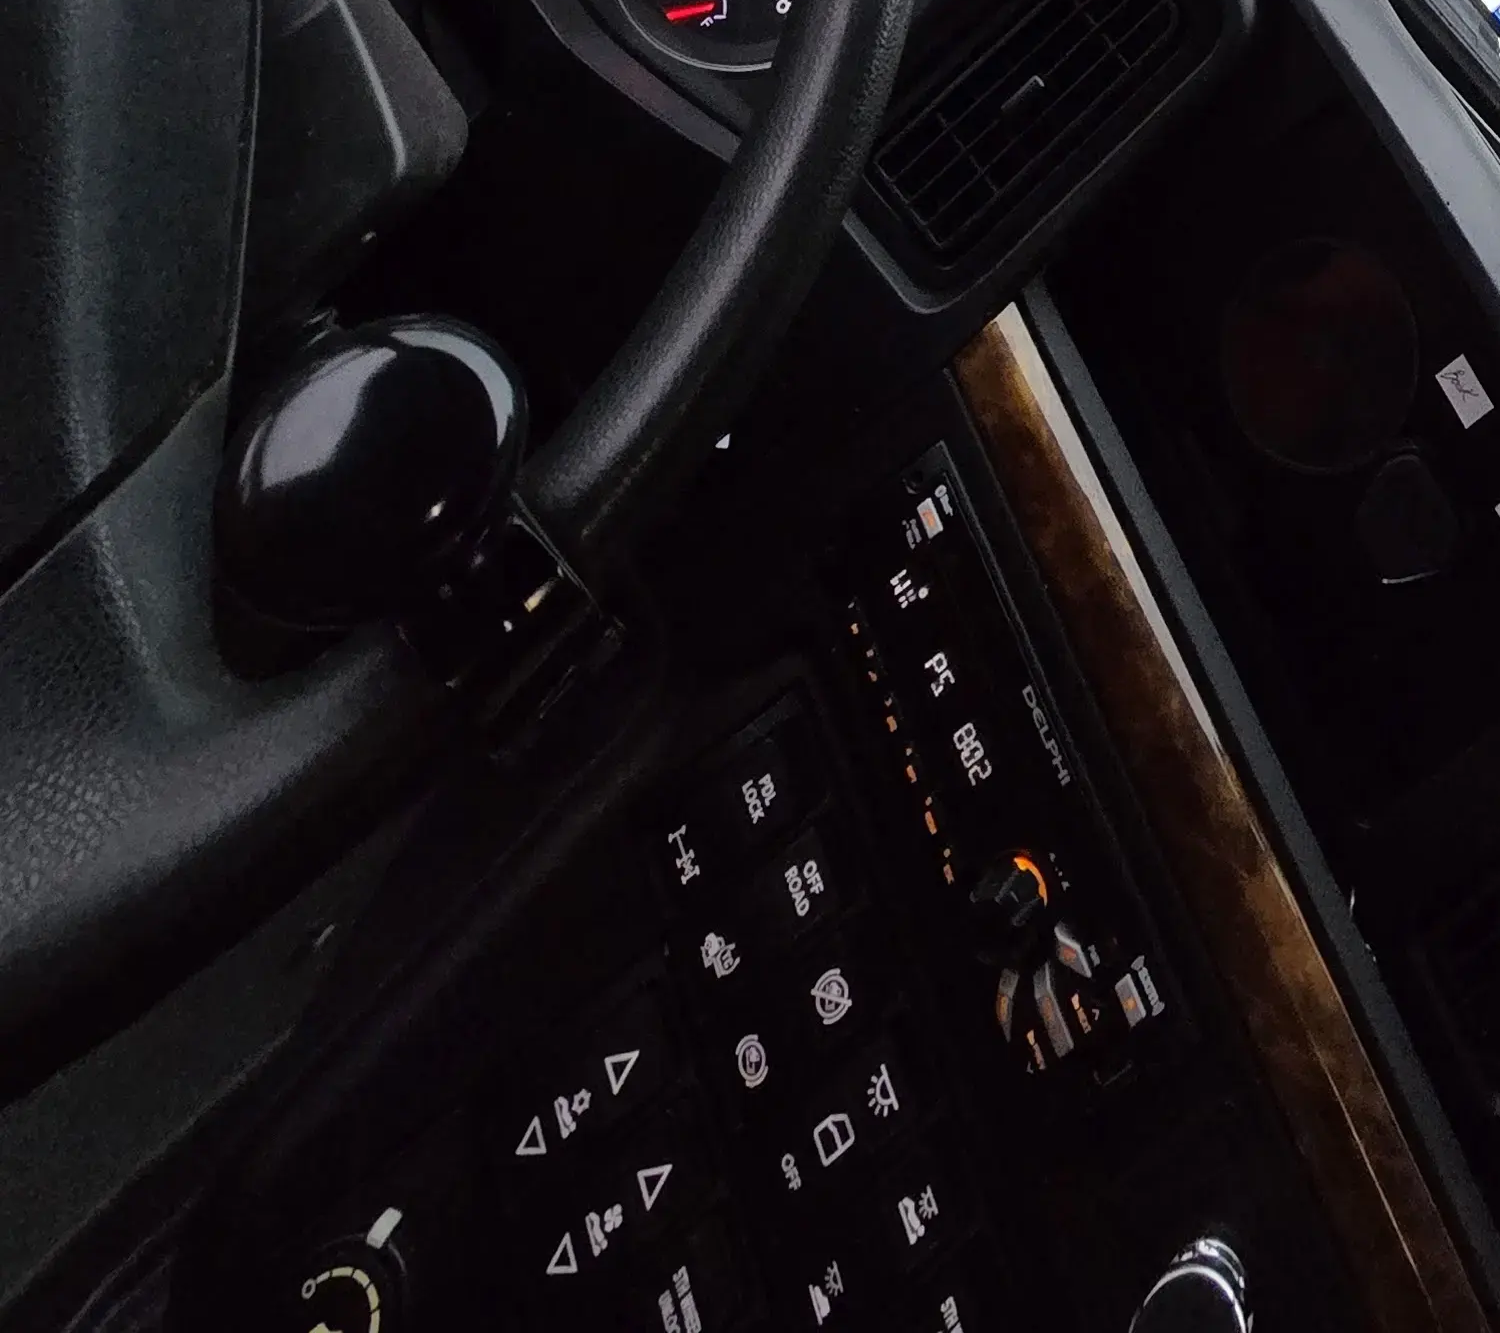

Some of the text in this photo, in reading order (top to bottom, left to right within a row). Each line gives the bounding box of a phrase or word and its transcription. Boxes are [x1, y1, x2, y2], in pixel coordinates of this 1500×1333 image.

[700, 16, 714, 29] F
[1022, 684, 1071, 786] DELPHI
[742, 779, 764, 824] LOCK
[758, 773, 776, 807] PDL
[784, 865, 810, 916] ROAD
[803, 860, 824, 894] OFF
[781, 1153, 801, 1191] OFF
